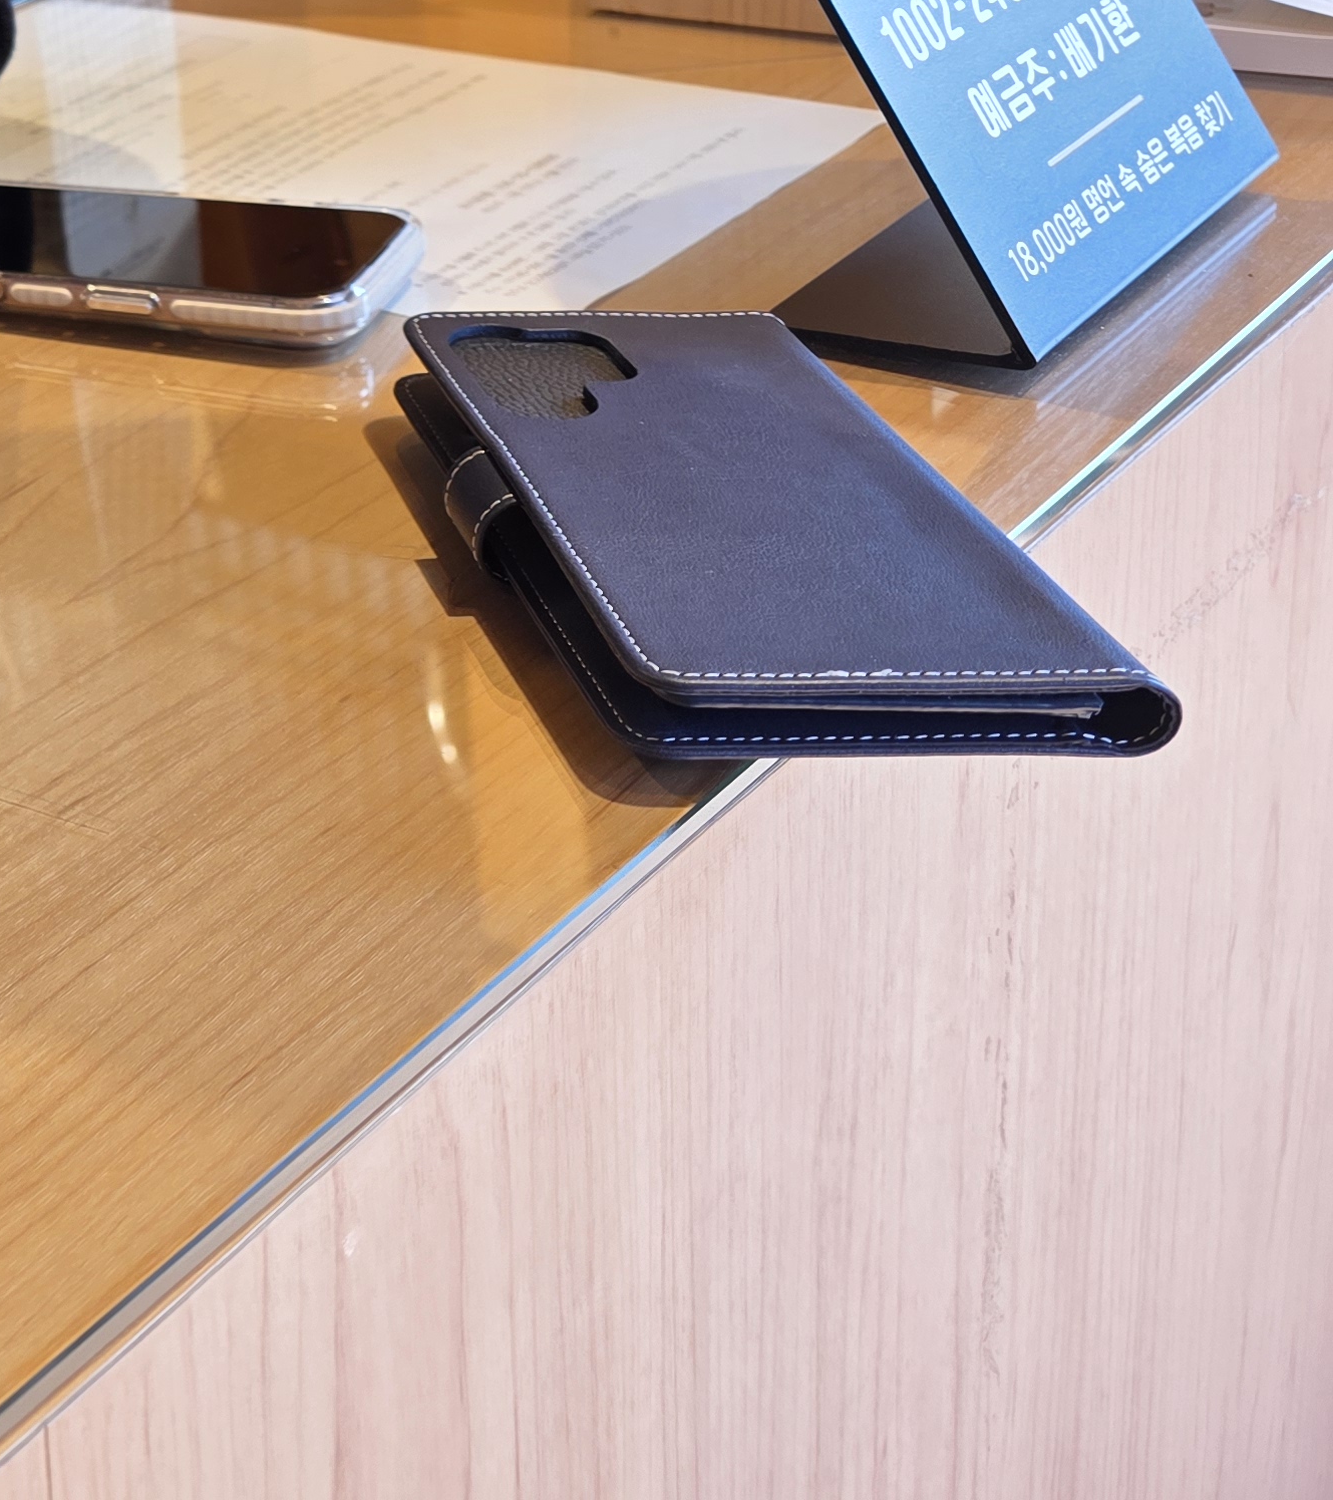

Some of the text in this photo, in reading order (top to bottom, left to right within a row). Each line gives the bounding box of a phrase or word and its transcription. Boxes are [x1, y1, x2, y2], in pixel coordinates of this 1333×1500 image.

[1008, 90, 1234, 282] 18,000원 명언 속 숨은 복음 찾기
